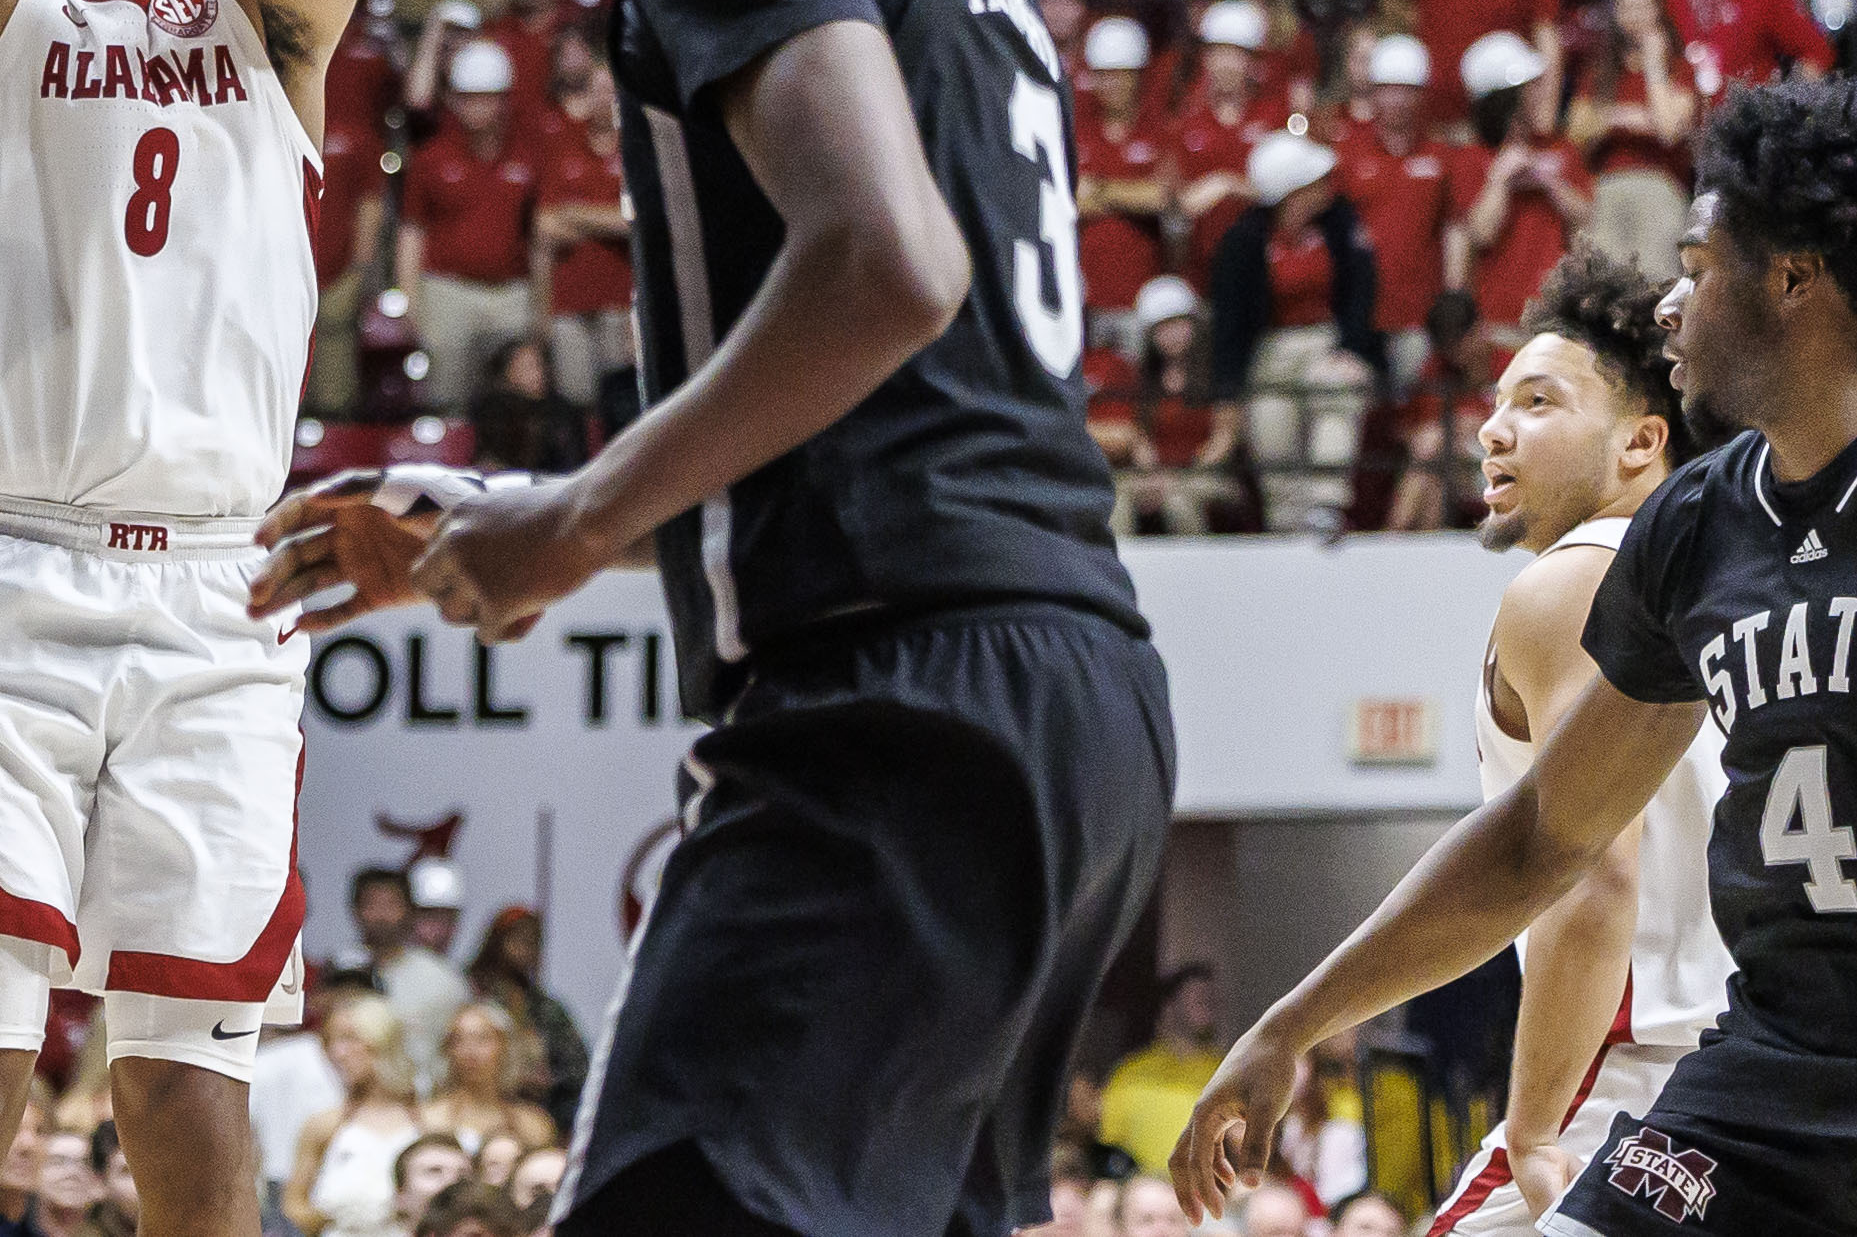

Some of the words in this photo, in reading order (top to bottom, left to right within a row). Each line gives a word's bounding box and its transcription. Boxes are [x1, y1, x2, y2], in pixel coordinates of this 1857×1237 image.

[124, 127, 180, 258] 8
[1008, 70, 1085, 381] 3
[107, 522, 168, 551] RTR
[1790, 548, 1828, 564] adidas
[308, 632, 528, 725] OLL
[568, 630, 706, 724] TI
[1760, 745, 1857, 913] 4
[1630, 1148, 1695, 1197] STATE
